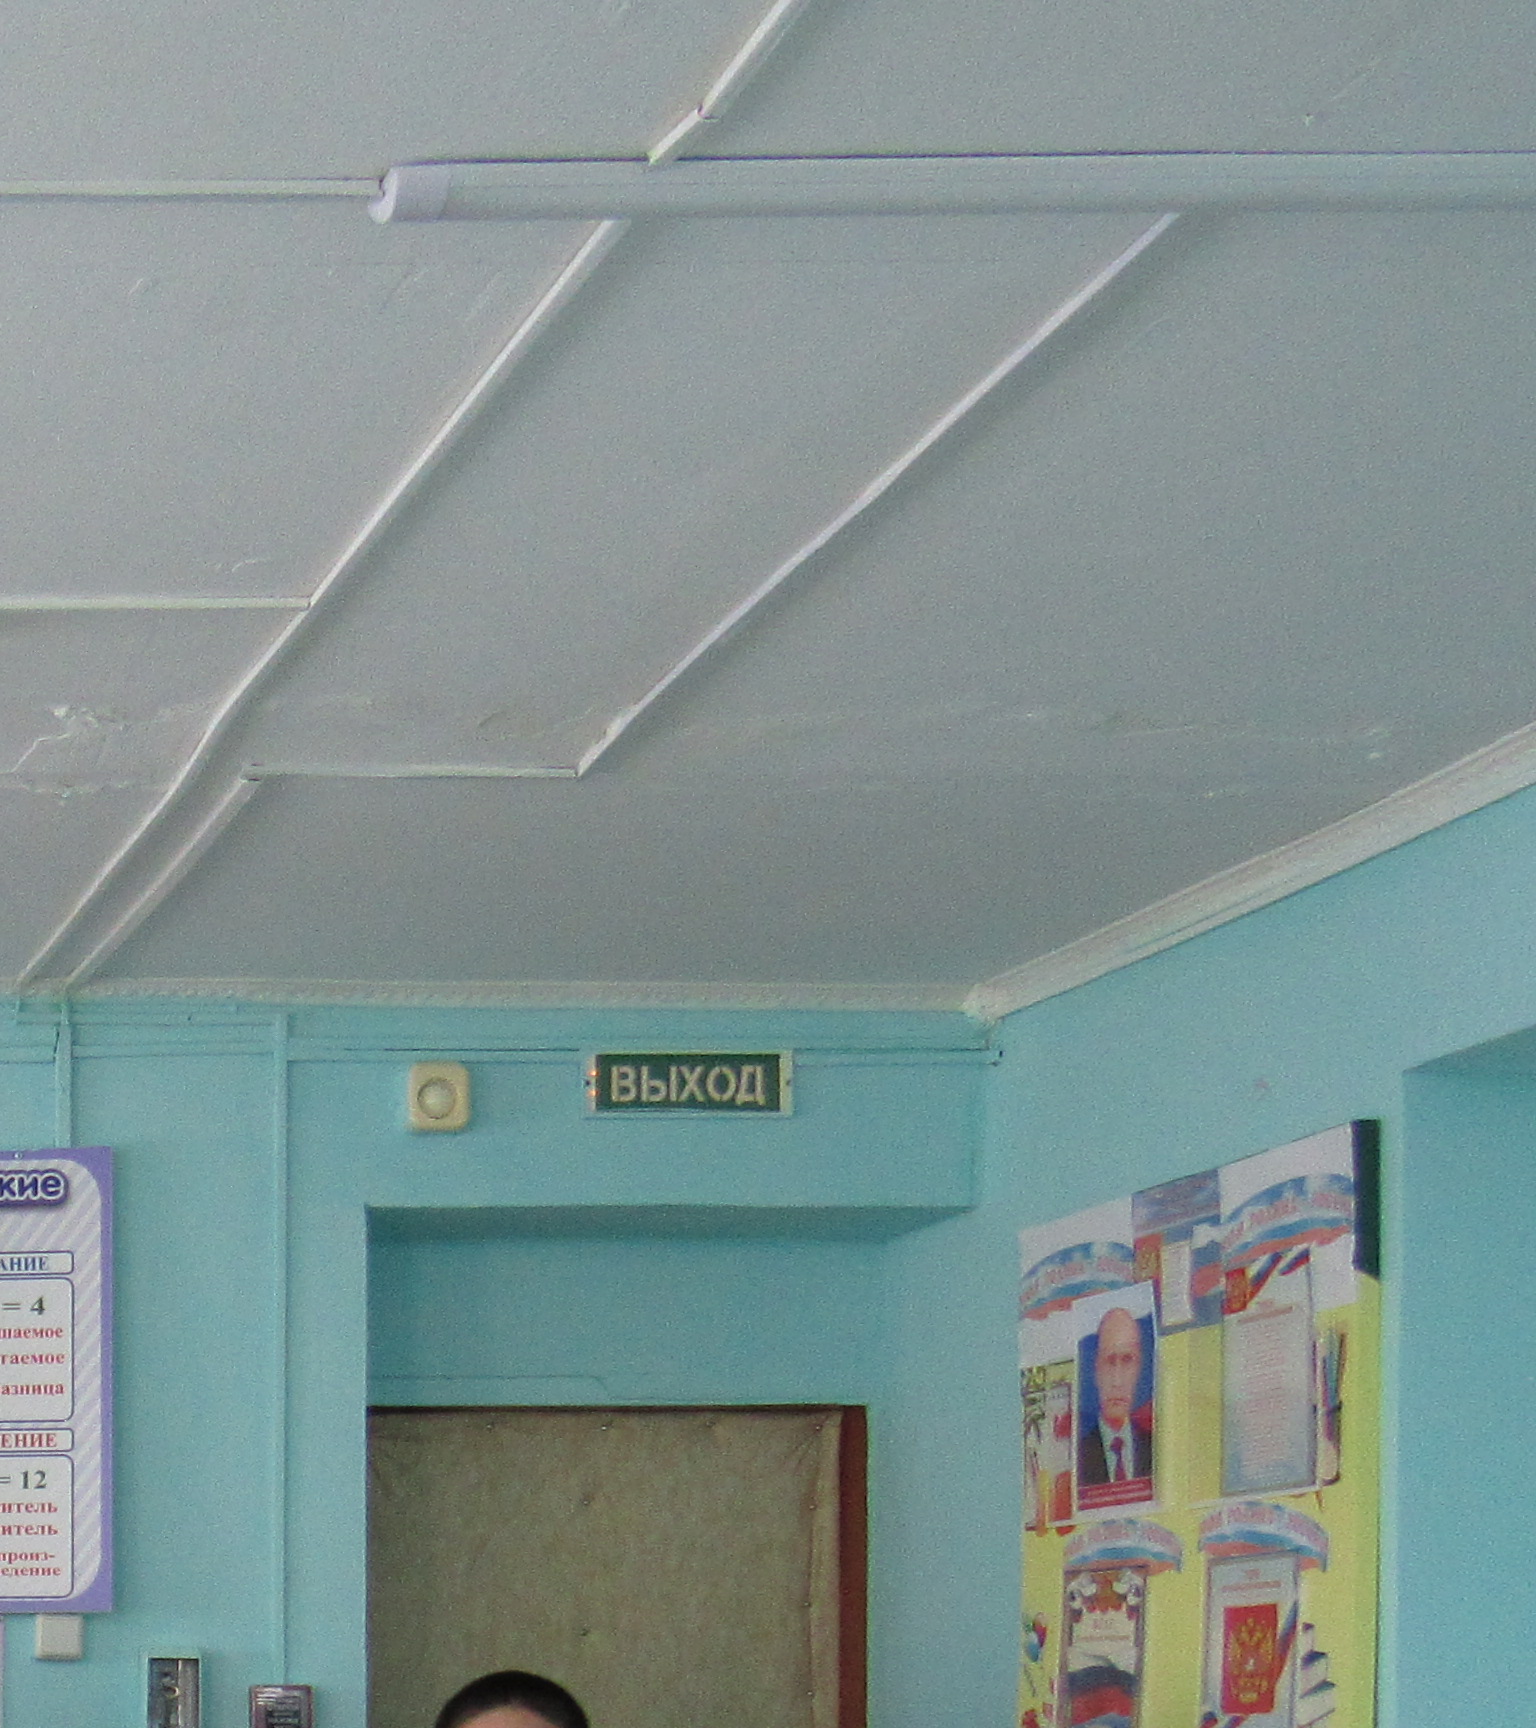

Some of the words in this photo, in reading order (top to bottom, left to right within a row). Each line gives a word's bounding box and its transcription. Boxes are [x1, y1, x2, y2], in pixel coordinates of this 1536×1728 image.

[611, 1066, 765, 1106] ВЫХОД
[30, 1296, 45, 1315] 4
[21, 1470, 47, 1489] 12
